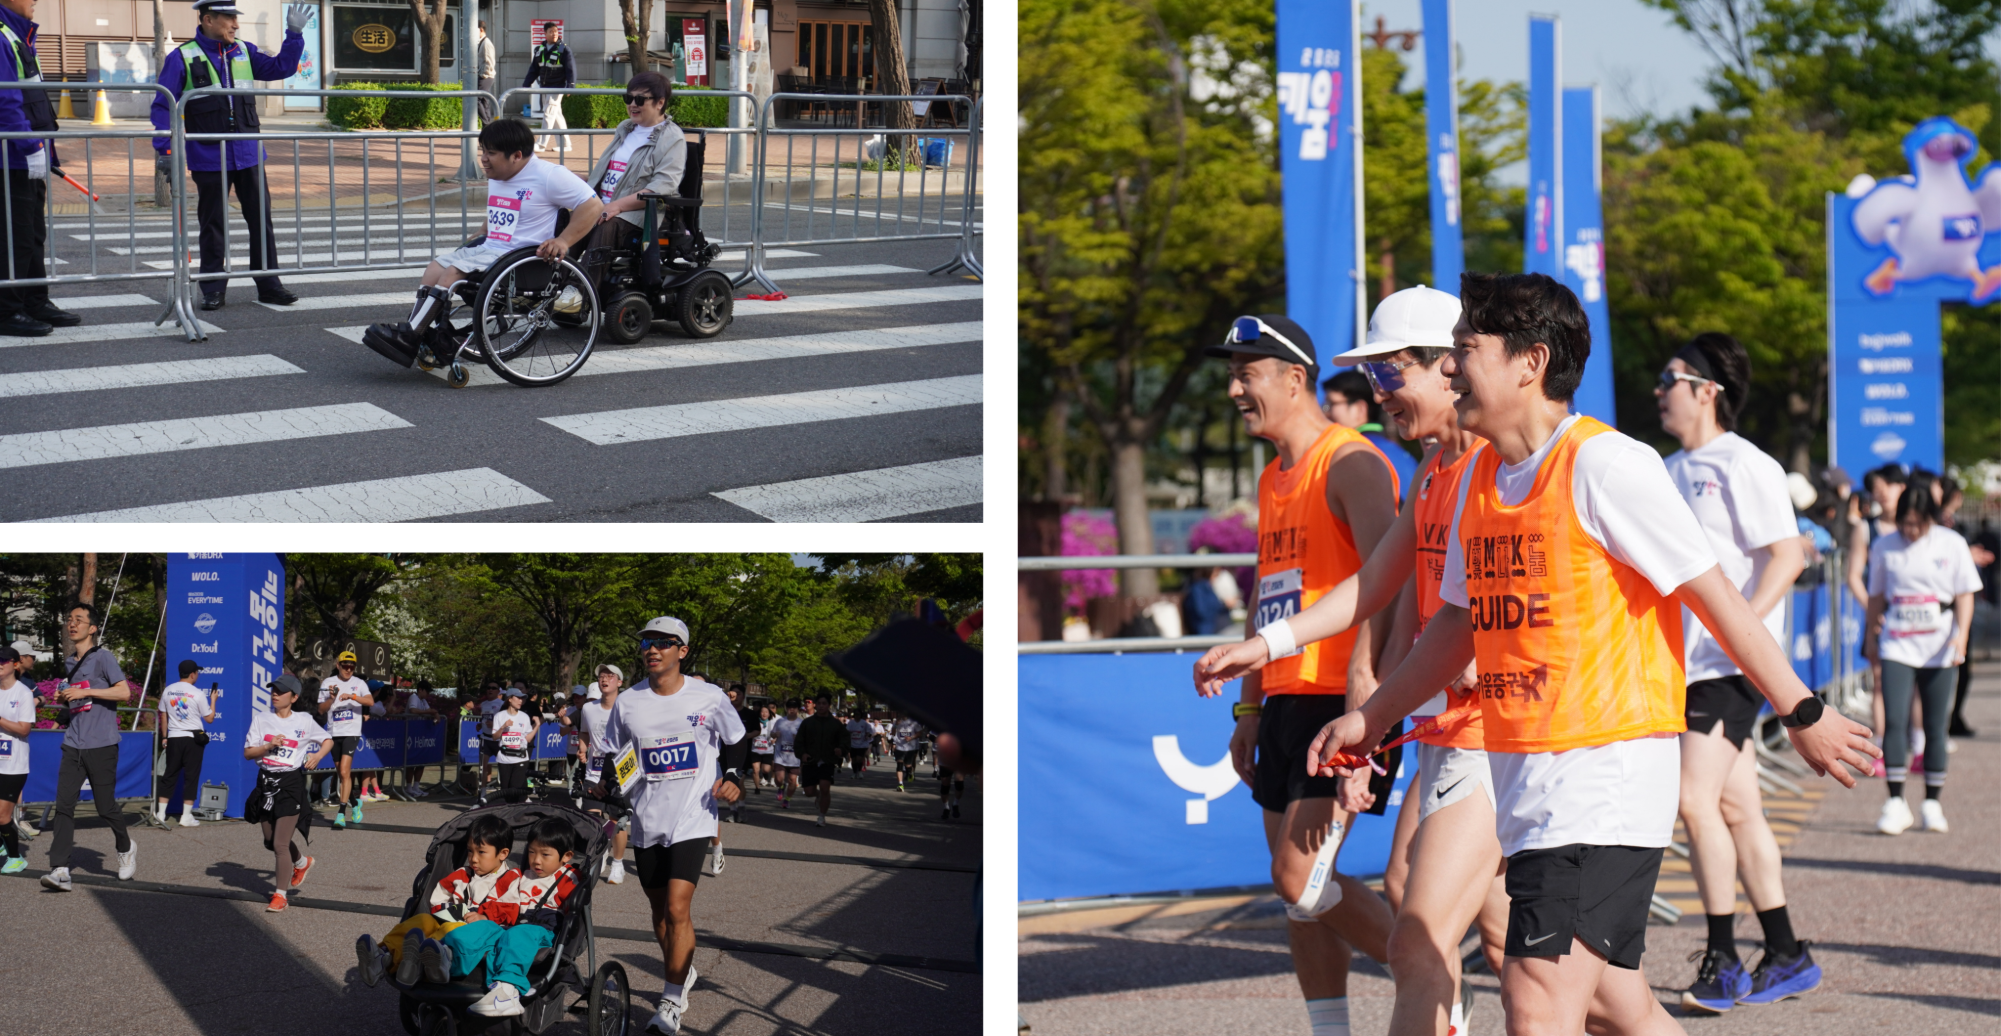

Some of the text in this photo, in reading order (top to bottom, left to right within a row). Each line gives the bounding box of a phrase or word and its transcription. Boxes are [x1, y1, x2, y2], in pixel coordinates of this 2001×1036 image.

[488, 209, 515, 227] 3639
[1469, 593, 1555, 633] GUIDE
[649, 746, 689, 766] 0017
